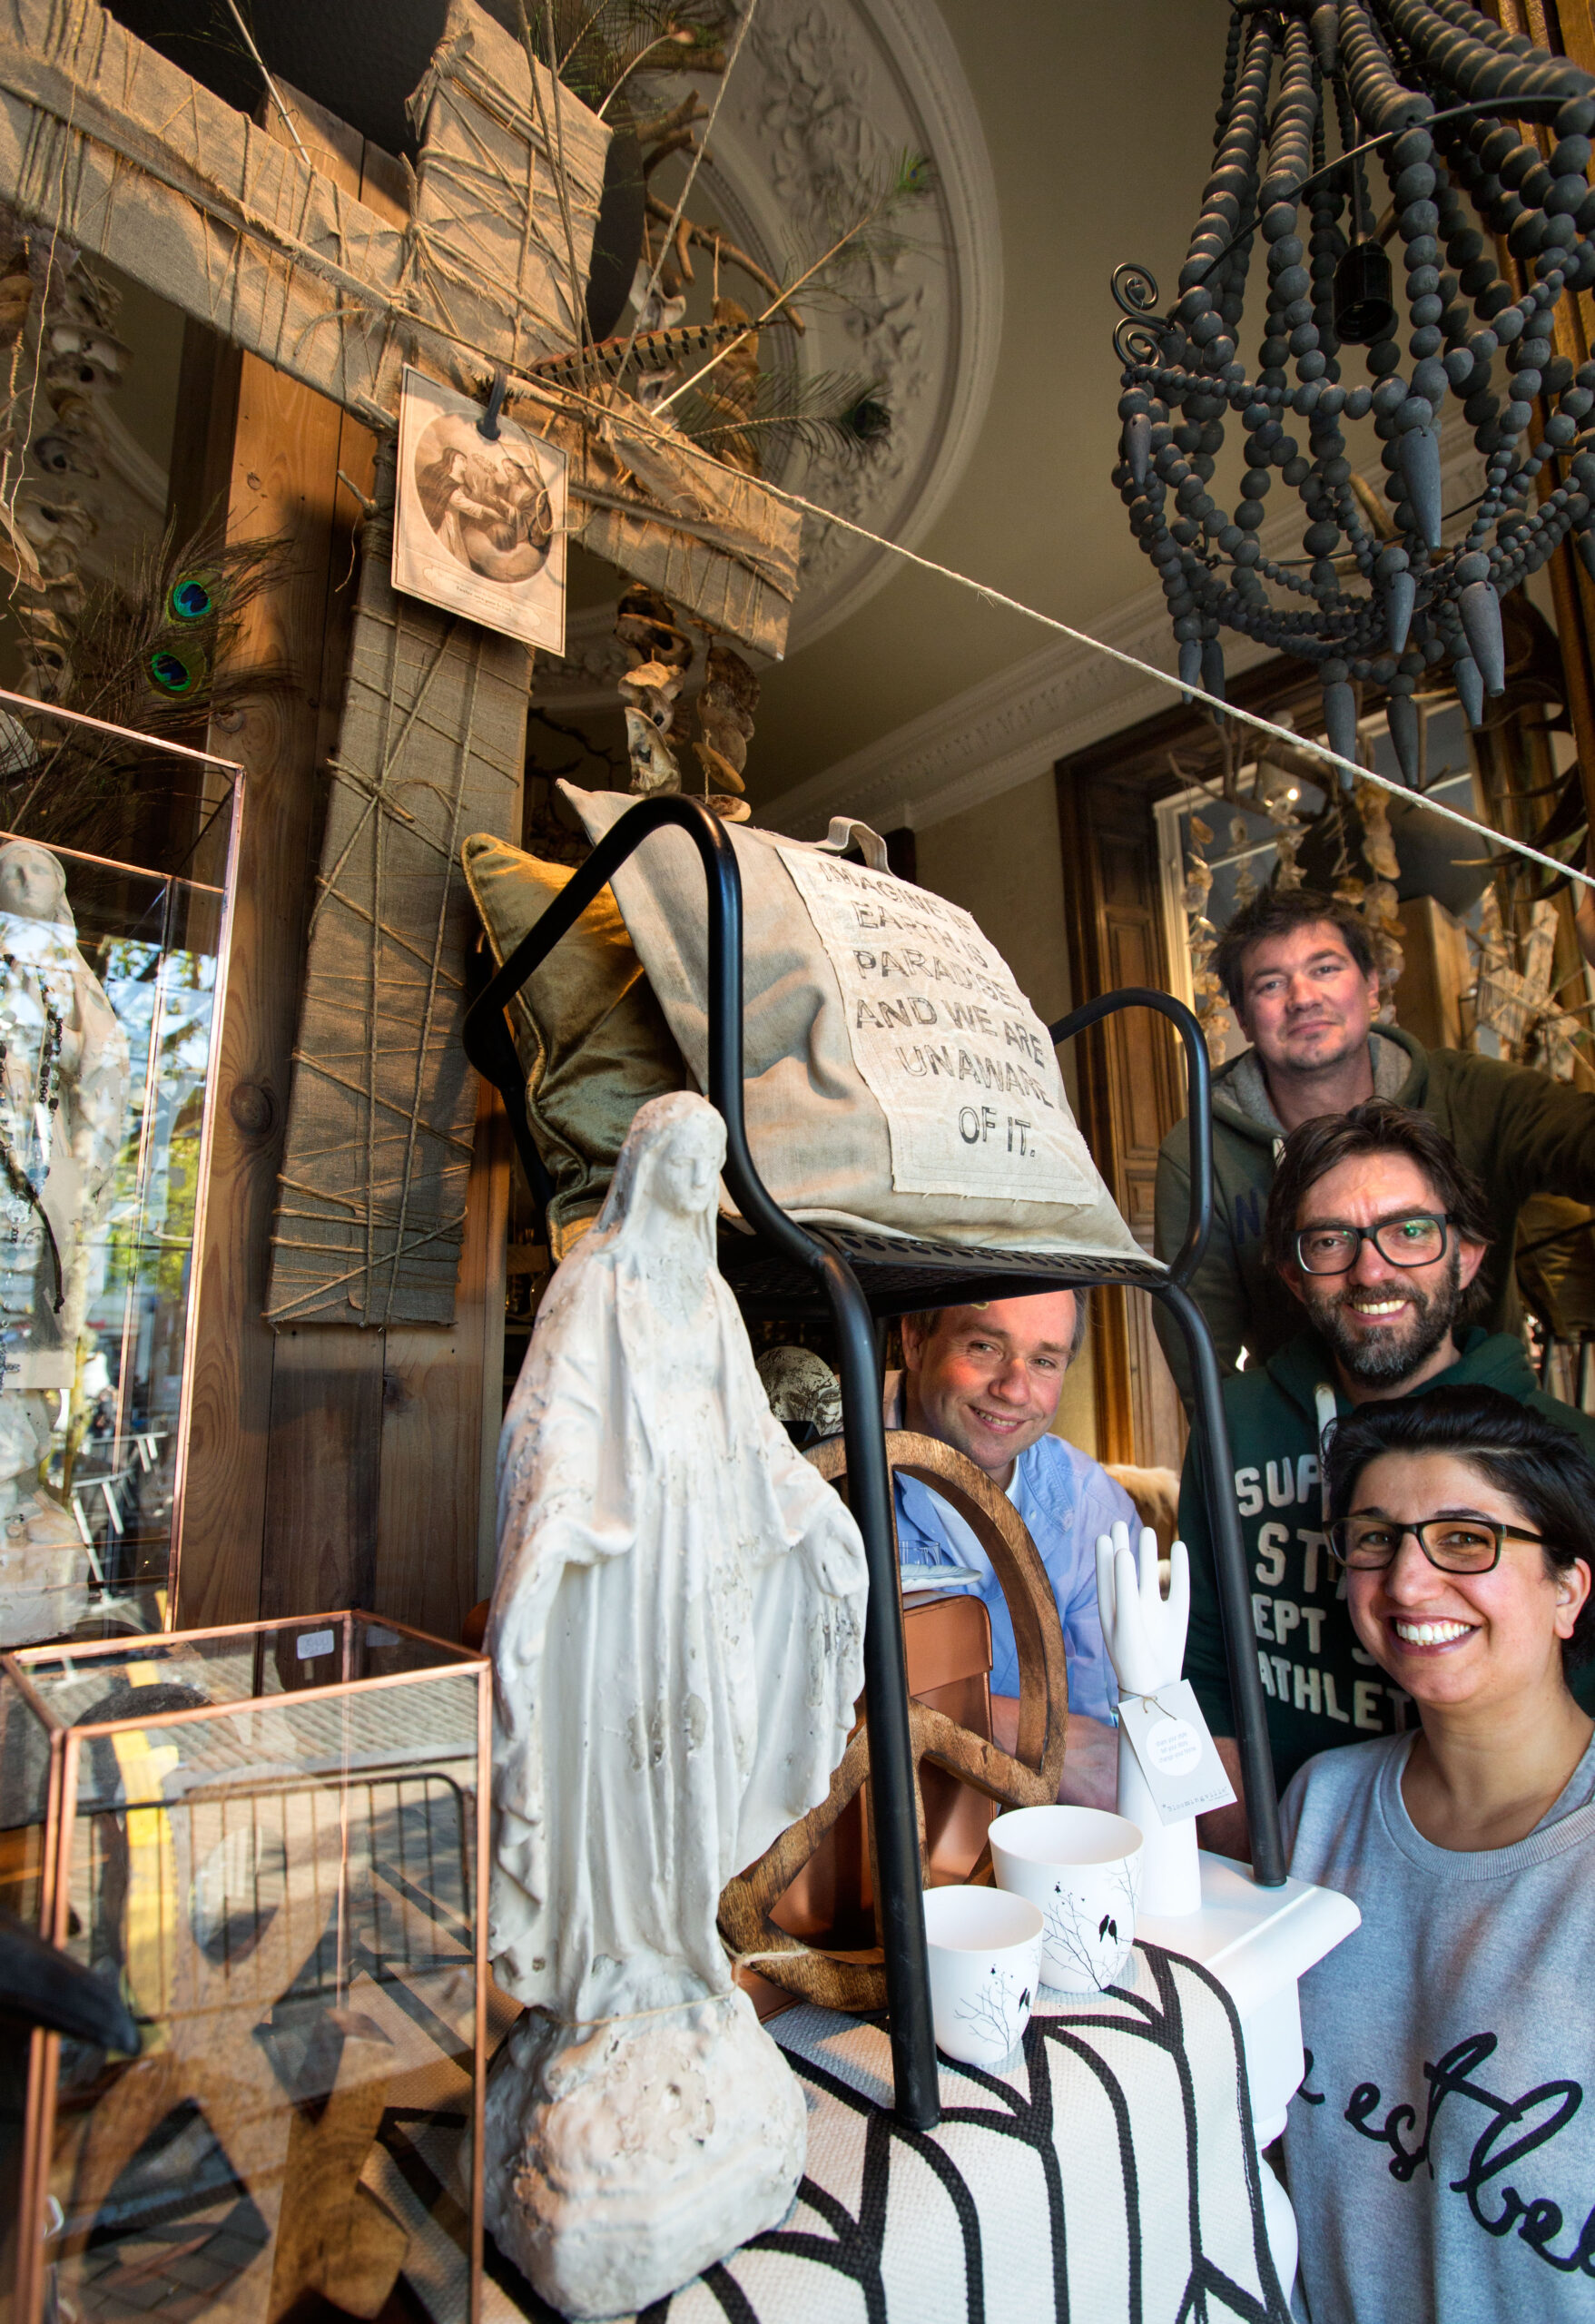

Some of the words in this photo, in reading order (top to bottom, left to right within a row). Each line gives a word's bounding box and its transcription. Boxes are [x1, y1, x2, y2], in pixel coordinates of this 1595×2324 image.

[817, 861, 949, 923] IMAGINE
[945, 909, 972, 936] IF
[850, 900, 960, 953] EARTH
[960, 939, 989, 969] IS
[852, 948, 1025, 1017] PARADISE,
[856, 996, 938, 1029] AND
[940, 999, 999, 1038] WE
[1002, 1019, 1046, 1069] ARE
[894, 1044, 1056, 1109] UNAWARE
[958, 1105, 998, 1145] OF
[1007, 1116, 1036, 1158] IT.
[1234, 1453, 1323, 1517] SUP
[1255, 1521, 1346, 1600] ST
[1251, 1592, 1327, 1654] EPT
[1256, 1650, 1413, 1733] ATHLET
